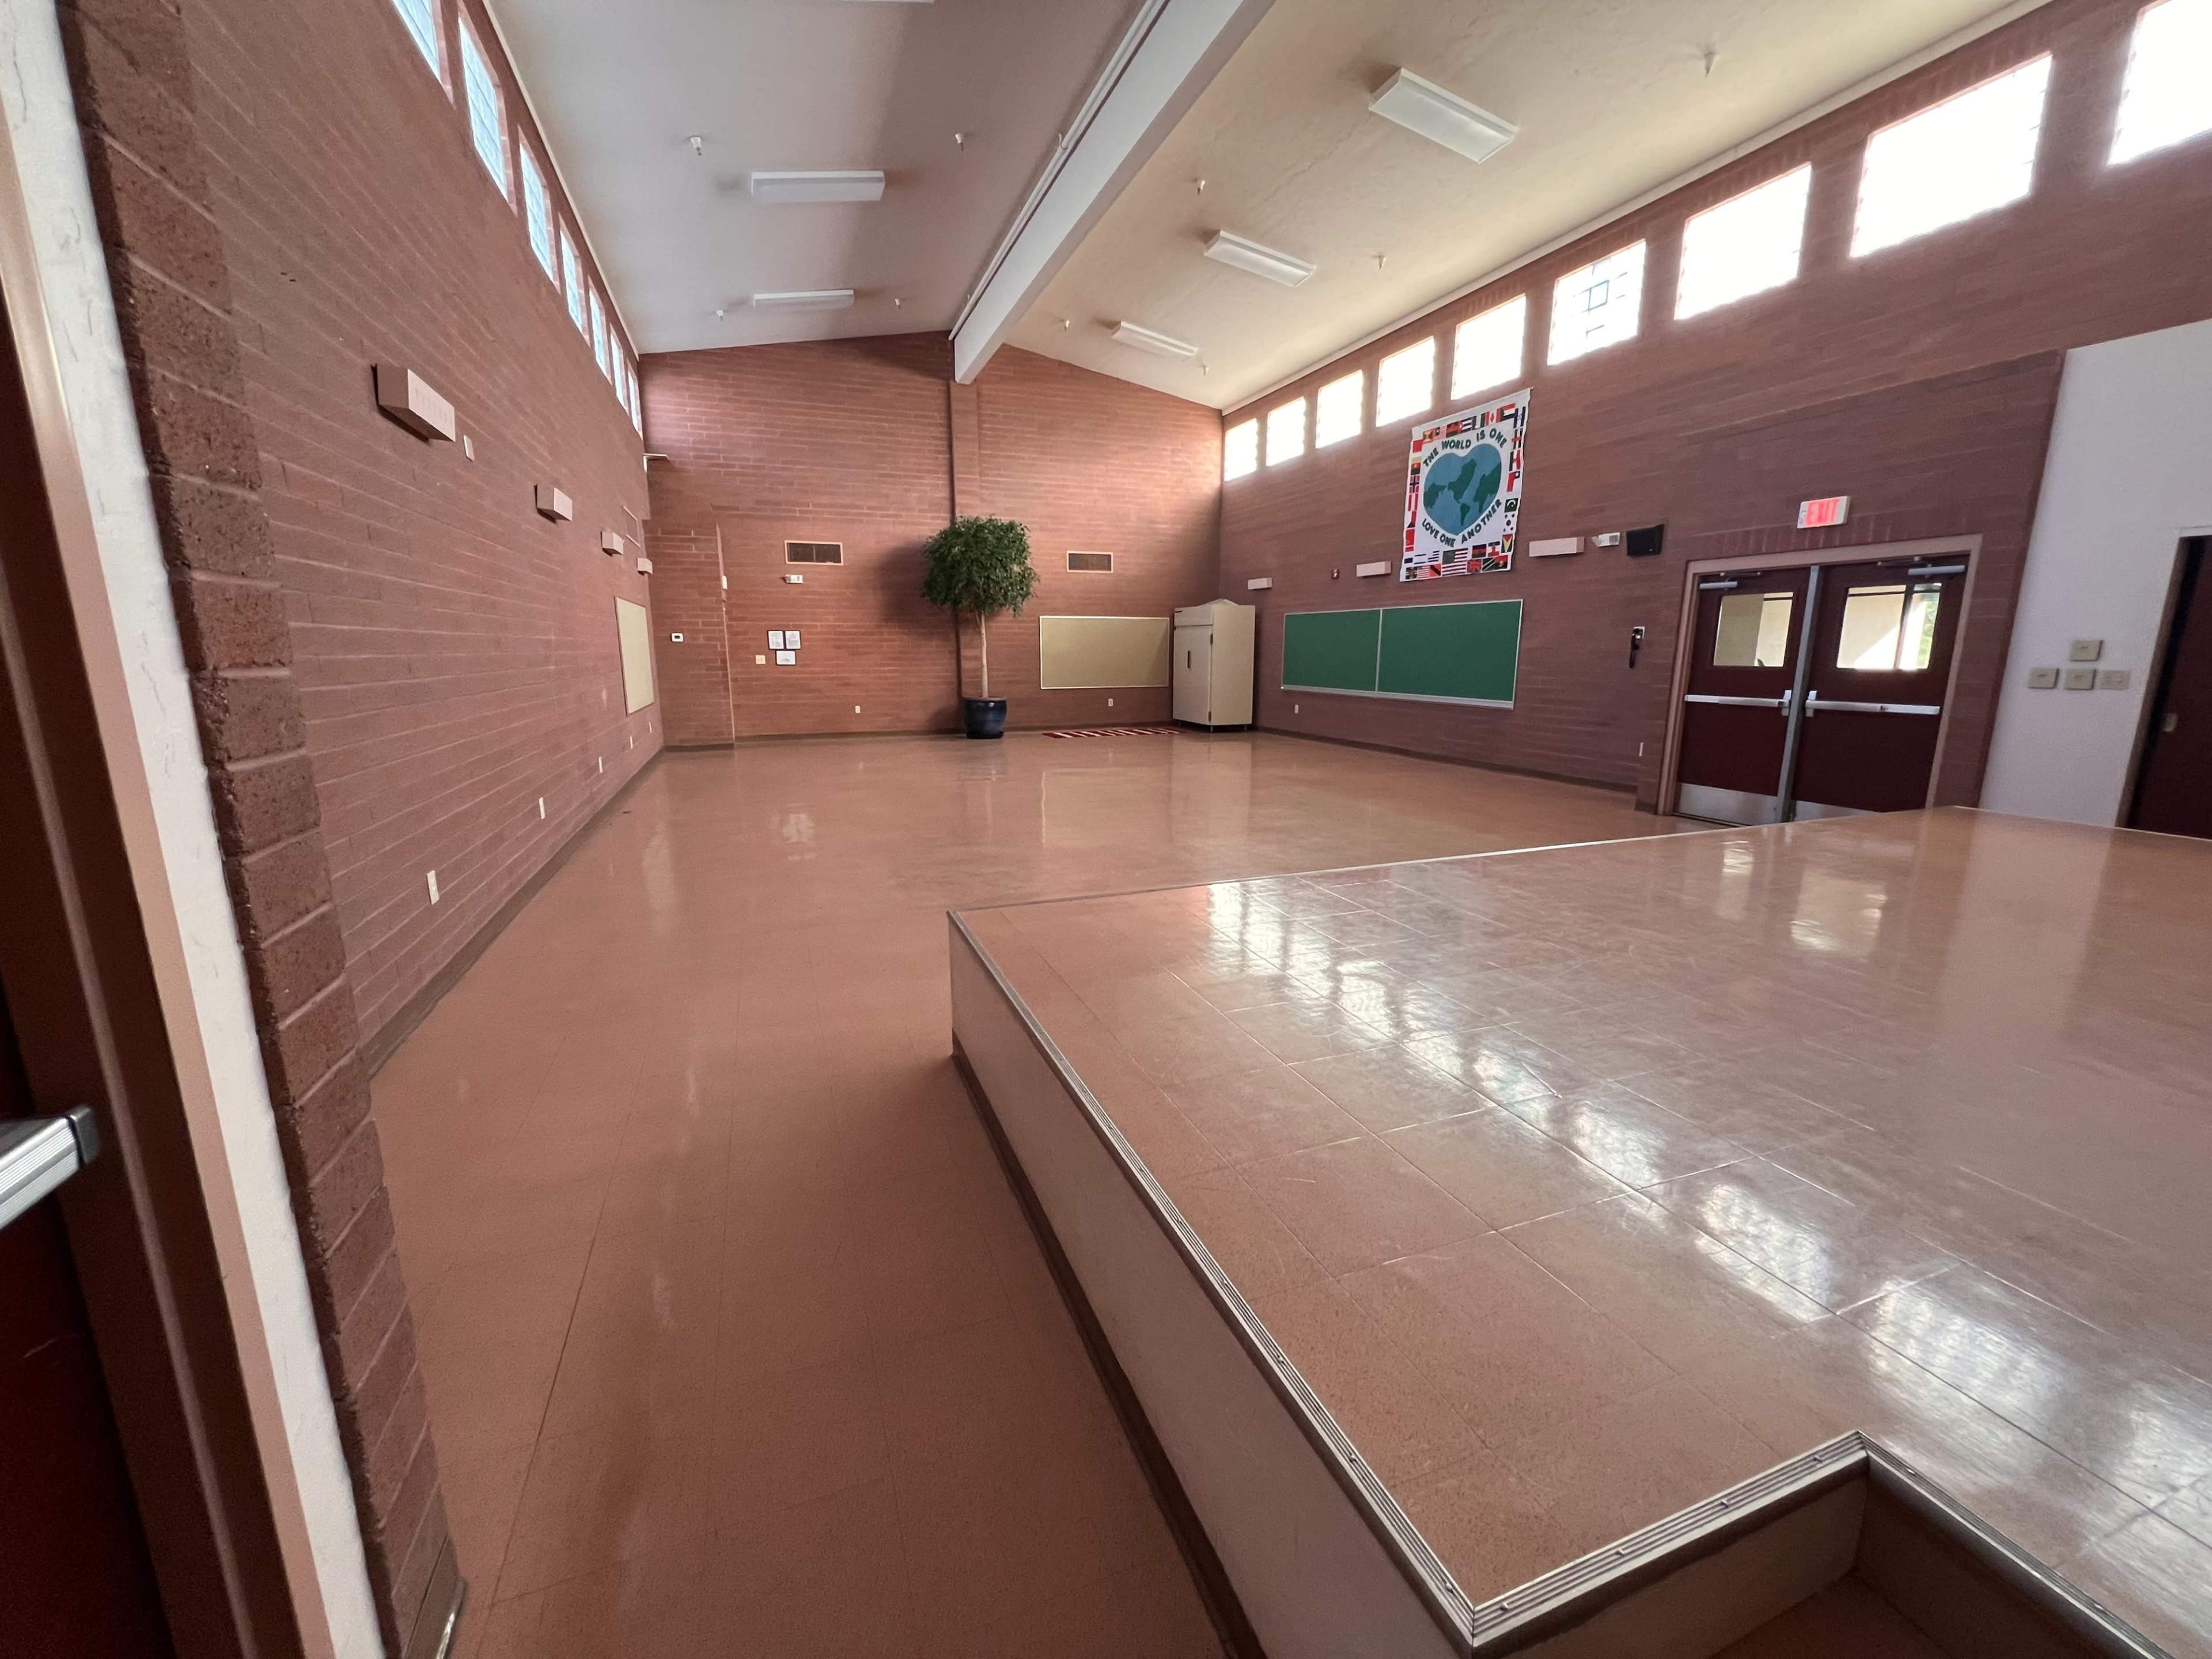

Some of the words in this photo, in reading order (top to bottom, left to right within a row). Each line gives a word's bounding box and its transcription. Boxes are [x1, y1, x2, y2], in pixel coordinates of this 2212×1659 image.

[1423, 448, 1438, 467] THE
[1442, 439, 1472, 450] WORLD
[1476, 430, 1485, 442] IS
[1490, 428, 1507, 448] ONE
[1422, 518, 1438, 539] LOVE
[1440, 533, 1456, 548] ONE
[1461, 499, 1502, 544] ANOTHER
[1805, 498, 1840, 525] EXIT
